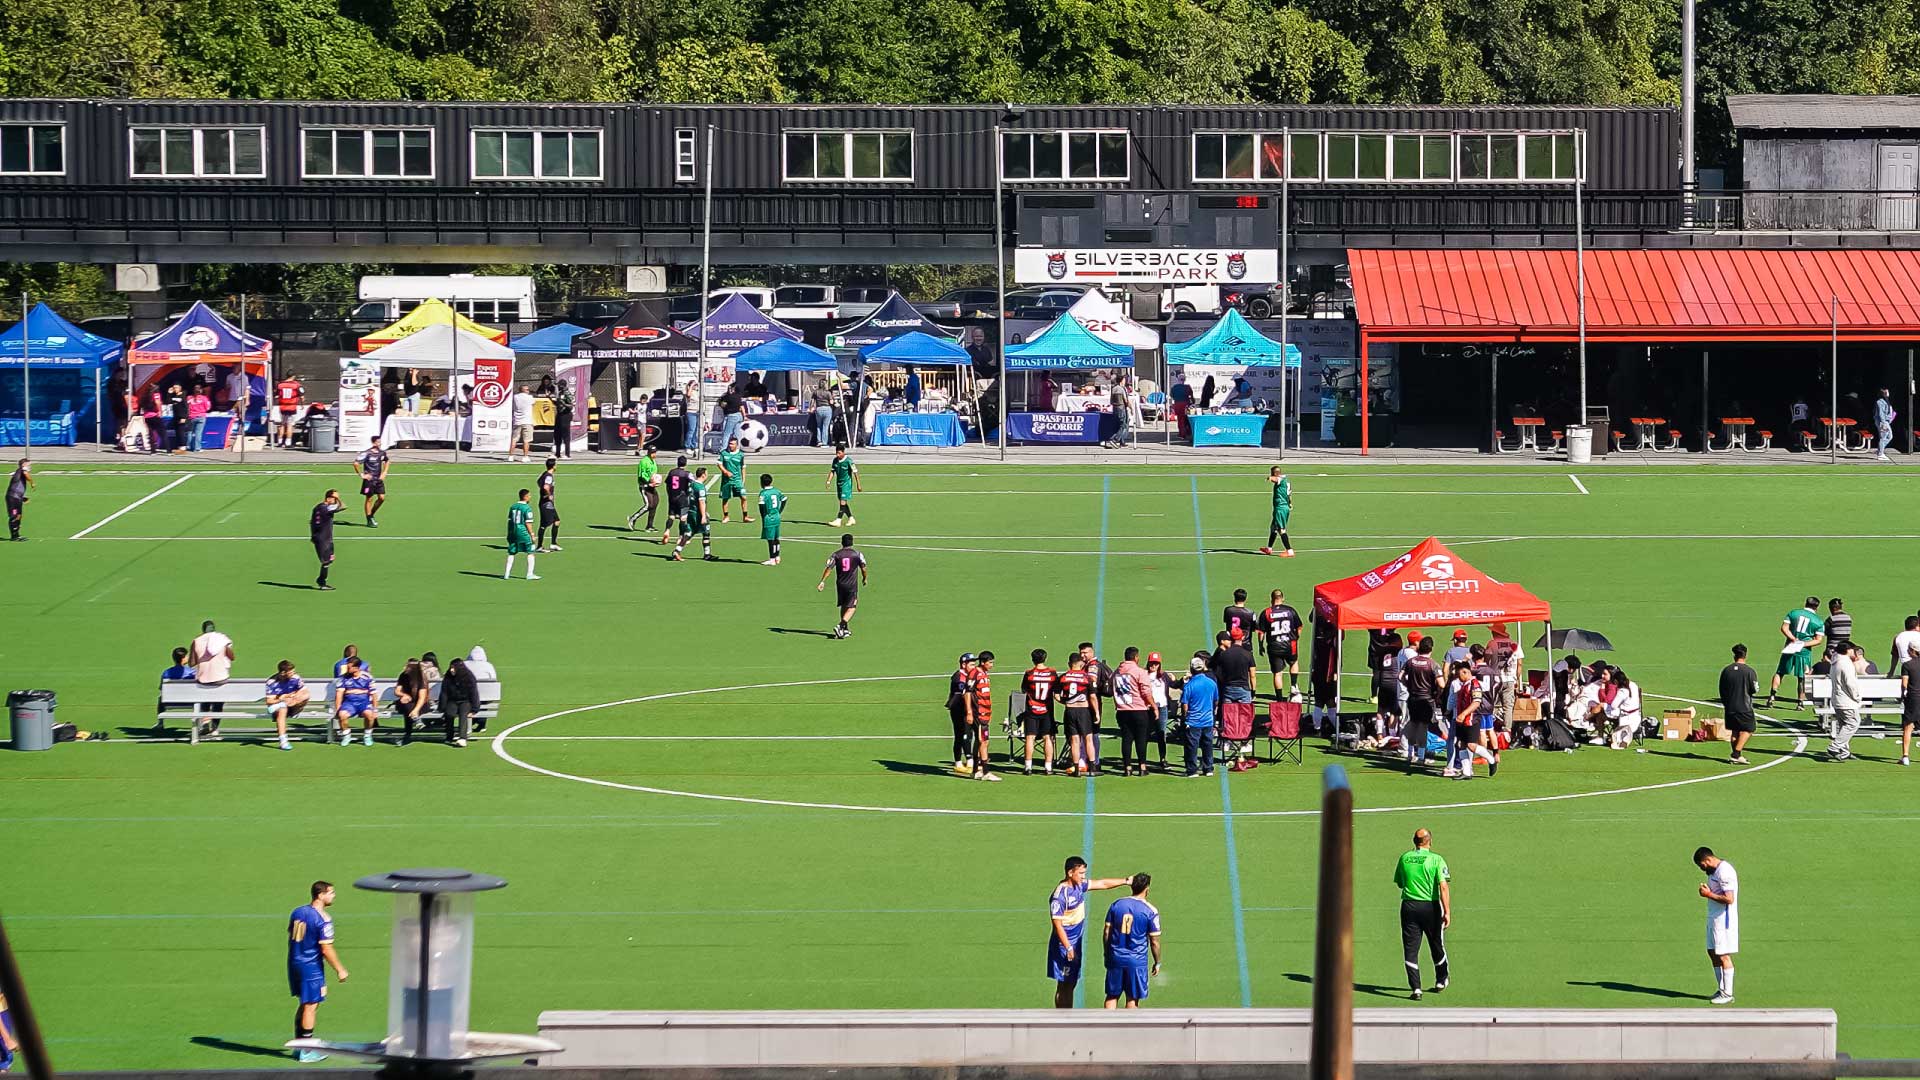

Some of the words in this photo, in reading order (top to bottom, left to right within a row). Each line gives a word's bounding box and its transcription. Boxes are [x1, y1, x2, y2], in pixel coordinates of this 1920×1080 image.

[1075, 253, 1217, 265] SILVERBACKS
[1159, 269, 1217, 279] PARK
[135, 352, 169, 360] FREE
[578, 350, 592, 358] FULL
[593, 350, 617, 358] SERVICE
[618, 350, 631, 358] FIRE
[632, 350, 667, 358] PROTECTION
[669, 350, 700, 358] SOLUTIONS
[1011, 358, 1066, 366] BRASFIELD
[1067, 355, 1081, 368] &
[1083, 358, 1122, 366] GORRIE
[1032, 414, 1084, 423] BRASFIELD
[1032, 421, 1046, 435] &
[1046, 423, 1083, 431] GORRIE
[672, 476, 680, 490] 5
[771, 495, 777, 508] 3
[842, 558, 850, 572] 9
[1402, 580, 1479, 591] GIBSON
[1796, 616, 1810, 633] 11
[1035, 682, 1049, 700] 17
[292, 919, 307, 942] 10
